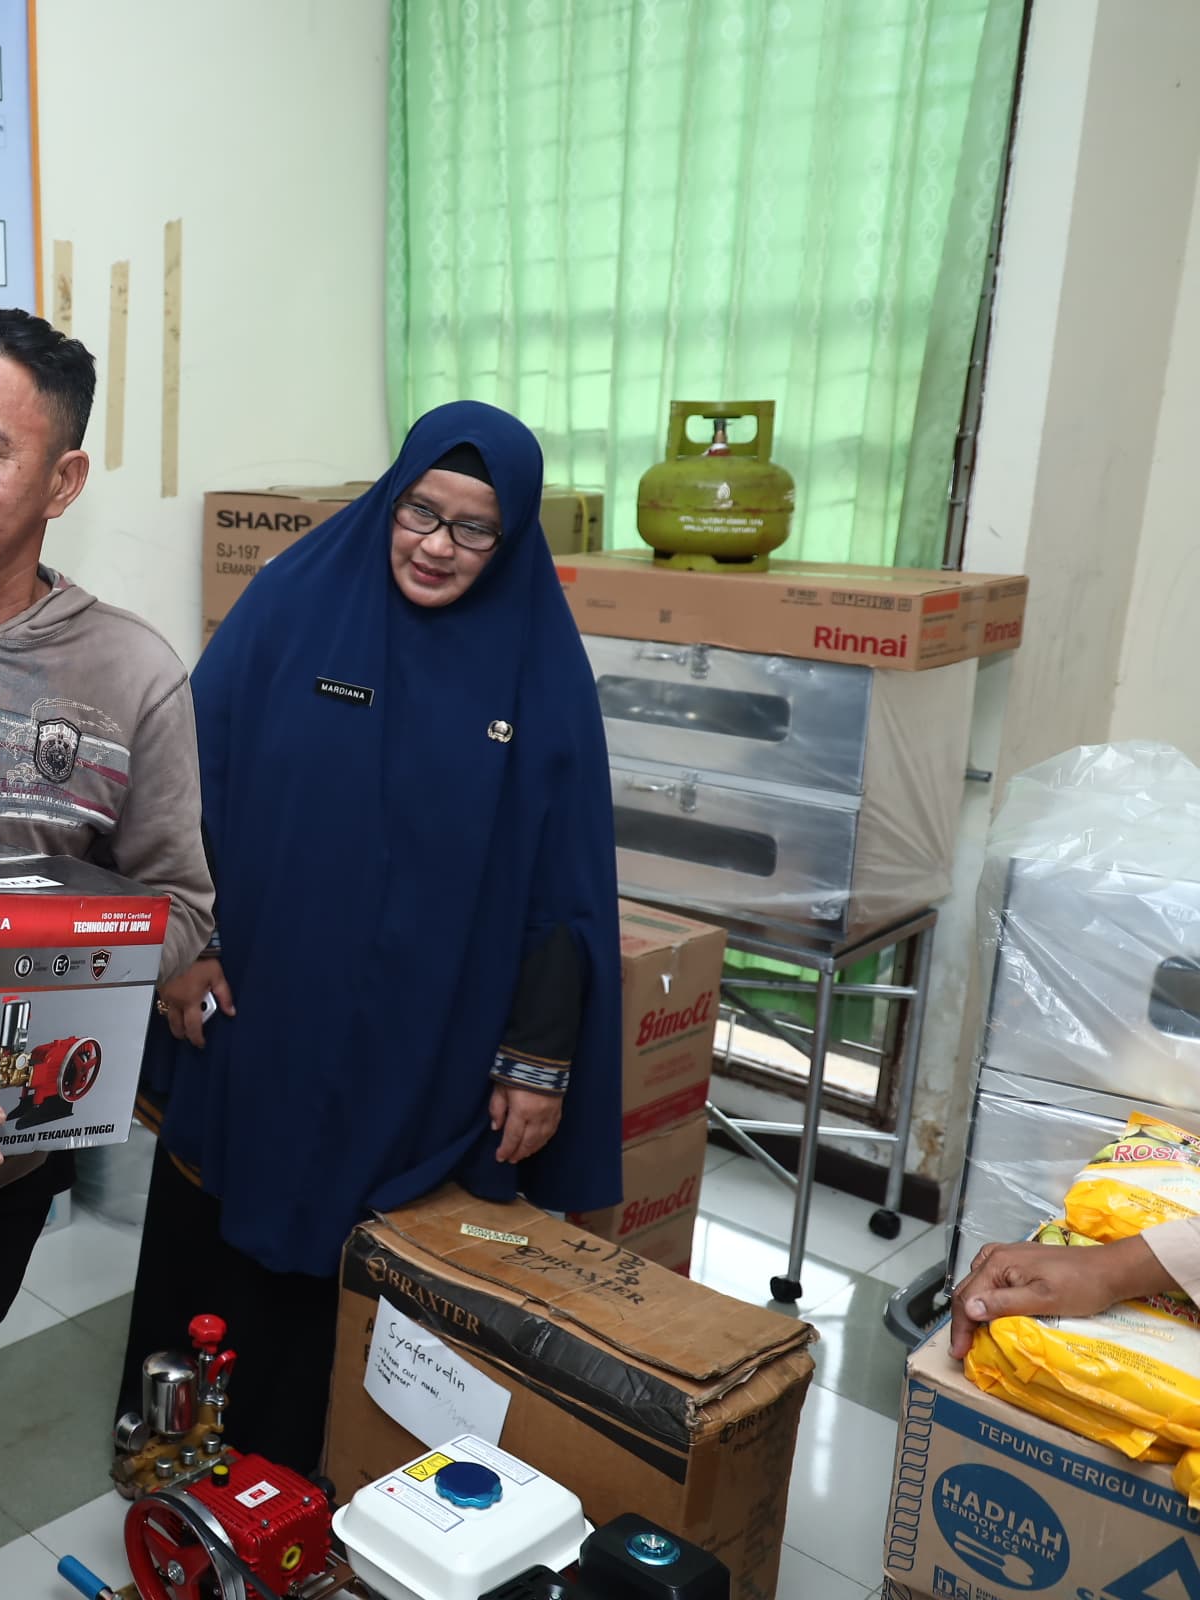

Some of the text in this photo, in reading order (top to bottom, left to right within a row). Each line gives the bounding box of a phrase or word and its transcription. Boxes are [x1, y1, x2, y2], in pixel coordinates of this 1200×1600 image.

[216, 509, 313, 532] SHARP
[216, 542, 260, 560] SJ-197
[813, 625, 908, 658] Rinnai
[321, 682, 365, 700] MARDIANA
[73, 920, 151, 933] TECHNOLOGY BY JAPAN
[102, 911, 152, 920] ISO 9001 Certified
[635, 991, 714, 1048] Bimoli
[37, 1127, 82, 1141] TEKANAN
[84, 1123, 115, 1136] TINGGI
[618, 1174, 697, 1237] Bimoli
[388, 1268, 481, 1336] BRAXTER
[978, 1420, 1054, 1466] TEPUNG
[1060, 1456, 1136, 1498] TERIGU
[942, 1477, 1063, 1551] HADIAH
[942, 1499, 1057, 1561] SENDOK CANTIK
[972, 1525, 1019, 1555] 12 PCS
